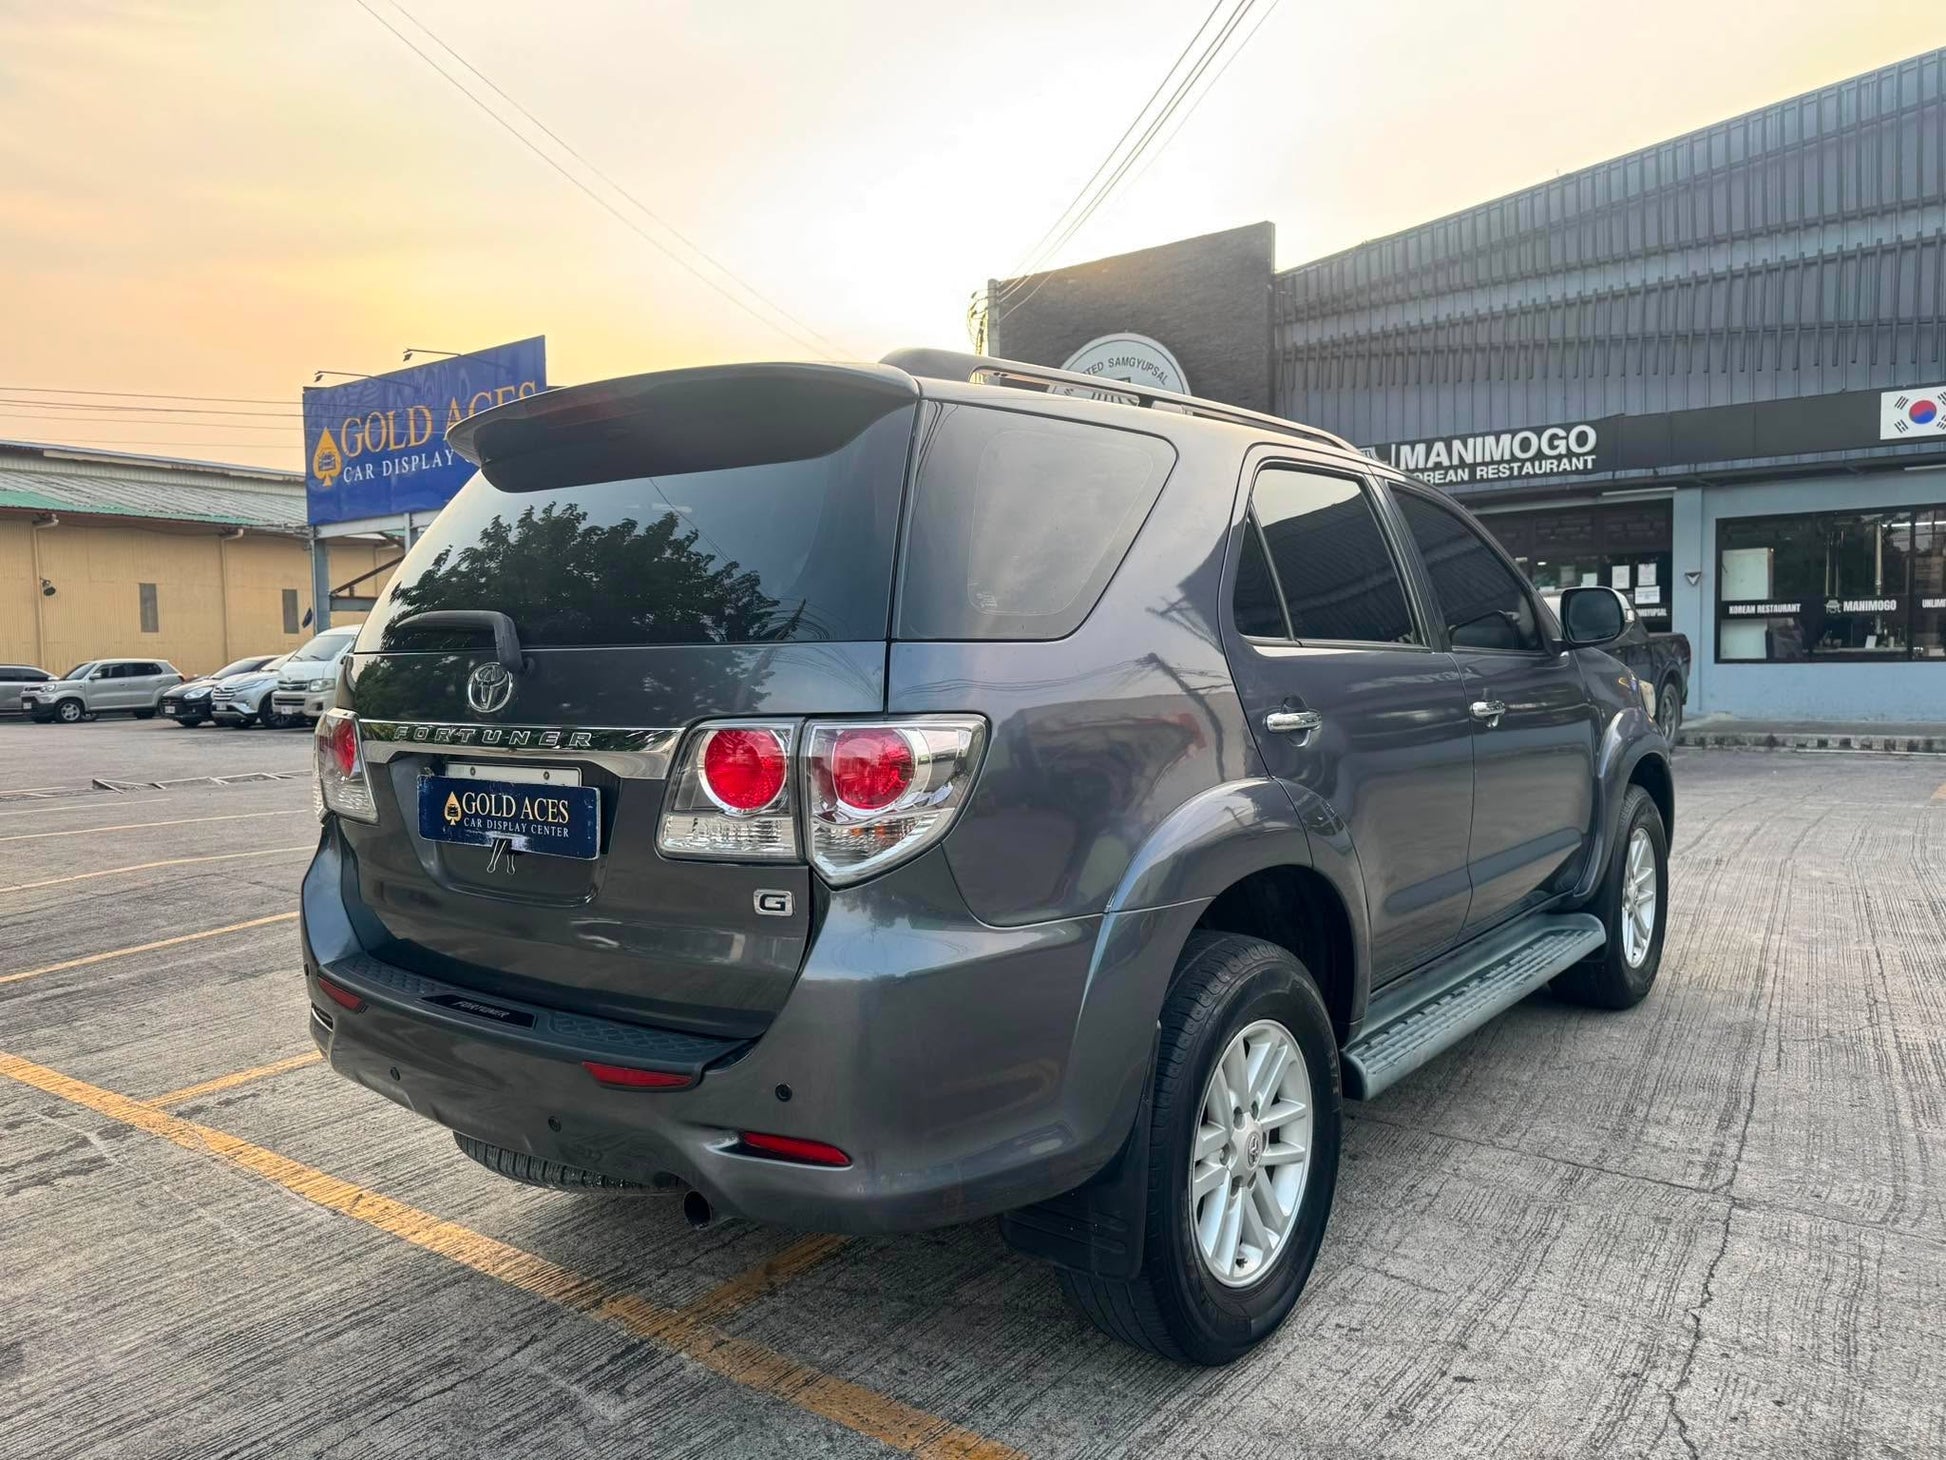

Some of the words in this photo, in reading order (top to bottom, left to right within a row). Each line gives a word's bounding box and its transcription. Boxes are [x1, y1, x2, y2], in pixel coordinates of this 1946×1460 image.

[1108, 356, 1169, 386] SAMGYUPSAL
[340, 404, 433, 458] GOLD
[1400, 424, 1597, 470] MANIMOGO
[343, 463, 375, 483] CAR
[382, 449, 454, 477] DISPLAY
[1475, 455, 1597, 481] RESTAURANT
[1729, 604, 1755, 614] KOREAN
[1843, 599, 1897, 612] MANIMOGO
[394, 726, 592, 747] FORTUNER
[462, 791, 516, 818] GOLD
[520, 796, 569, 824] ACES
[464, 818, 482, 828] CAR
[486, 820, 527, 833] DISPLAY
[530, 825, 569, 838] CENTER
[757, 891, 788, 914] G
